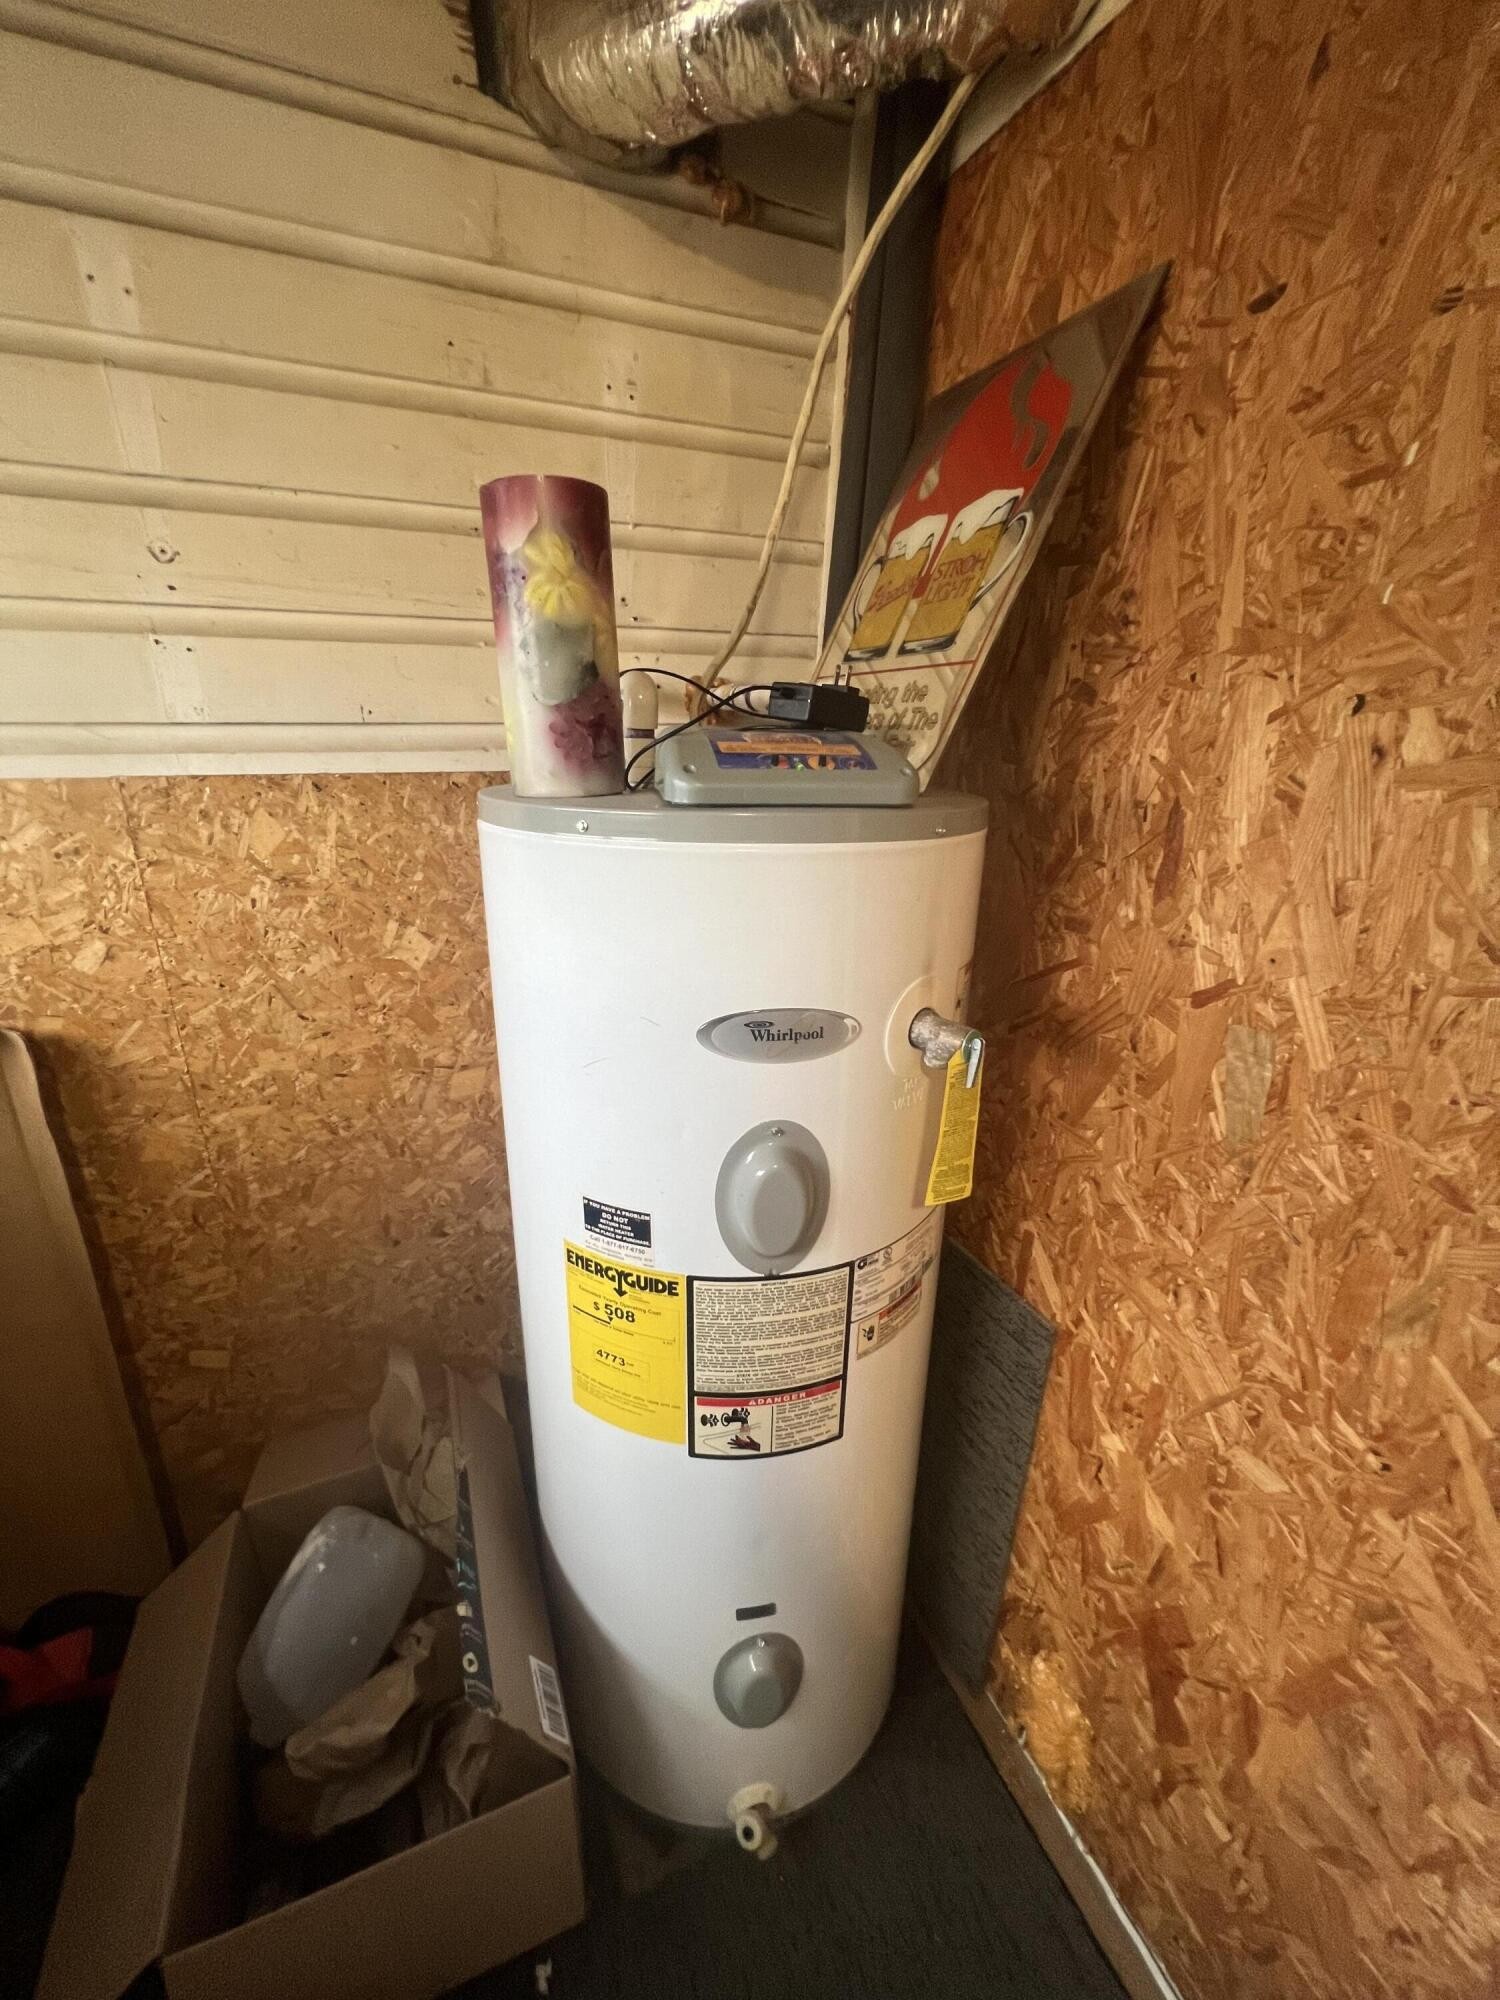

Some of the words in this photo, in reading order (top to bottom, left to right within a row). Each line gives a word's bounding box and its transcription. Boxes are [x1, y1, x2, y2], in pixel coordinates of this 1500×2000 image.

[902, 679, 929, 703] the
[888, 707, 908, 730] of
[907, 706, 938, 730] The
[750, 1026, 824, 1044] Whirlpool
[601, 1205, 616, 1214] HAVE
[622, 1211, 650, 1221] PROBLEM
[601, 1212, 612, 1220] DO
[613, 1215, 629, 1224] NOT
[566, 1247, 680, 1297] ENERGYGUIDE
[604, 1303, 636, 1323] 508
[596, 1349, 626, 1367] 4773
[757, 1392, 806, 1405] DANGER
